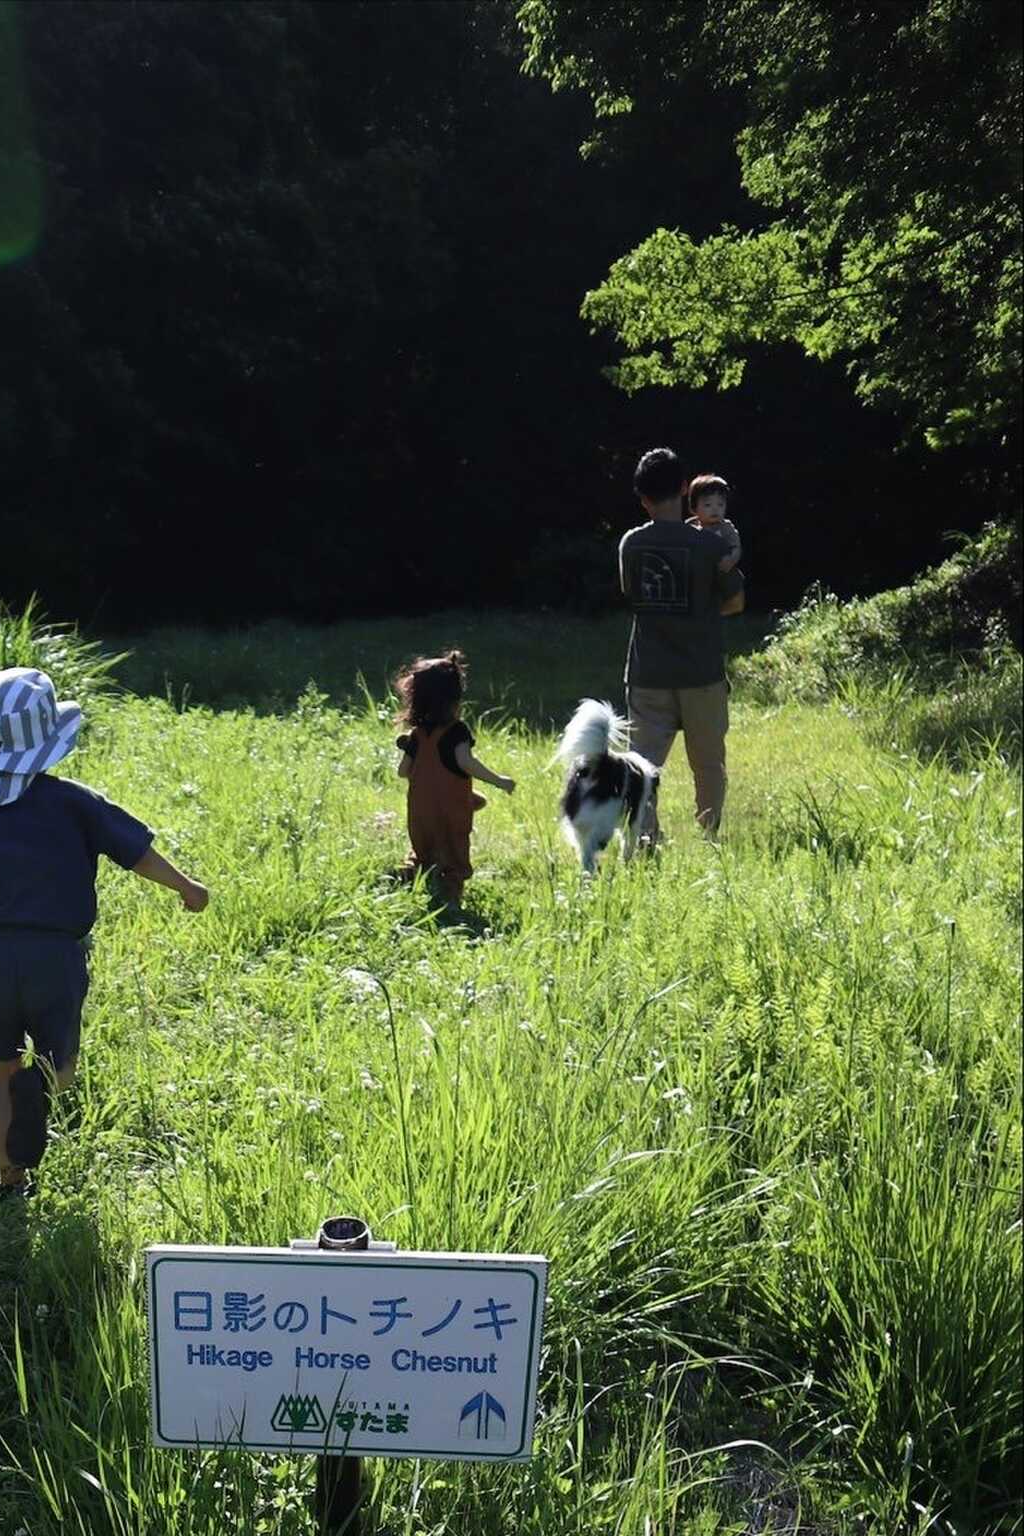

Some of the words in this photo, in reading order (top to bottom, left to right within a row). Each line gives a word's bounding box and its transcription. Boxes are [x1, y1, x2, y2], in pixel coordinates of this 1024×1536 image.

[174, 1291, 517, 1340] 日影のトチノキ
[187, 1344, 272, 1371] Hikage
[295, 1347, 370, 1369] Horse
[391, 1349, 497, 1373] Chesnut
[336, 1411, 409, 1433] すたま
